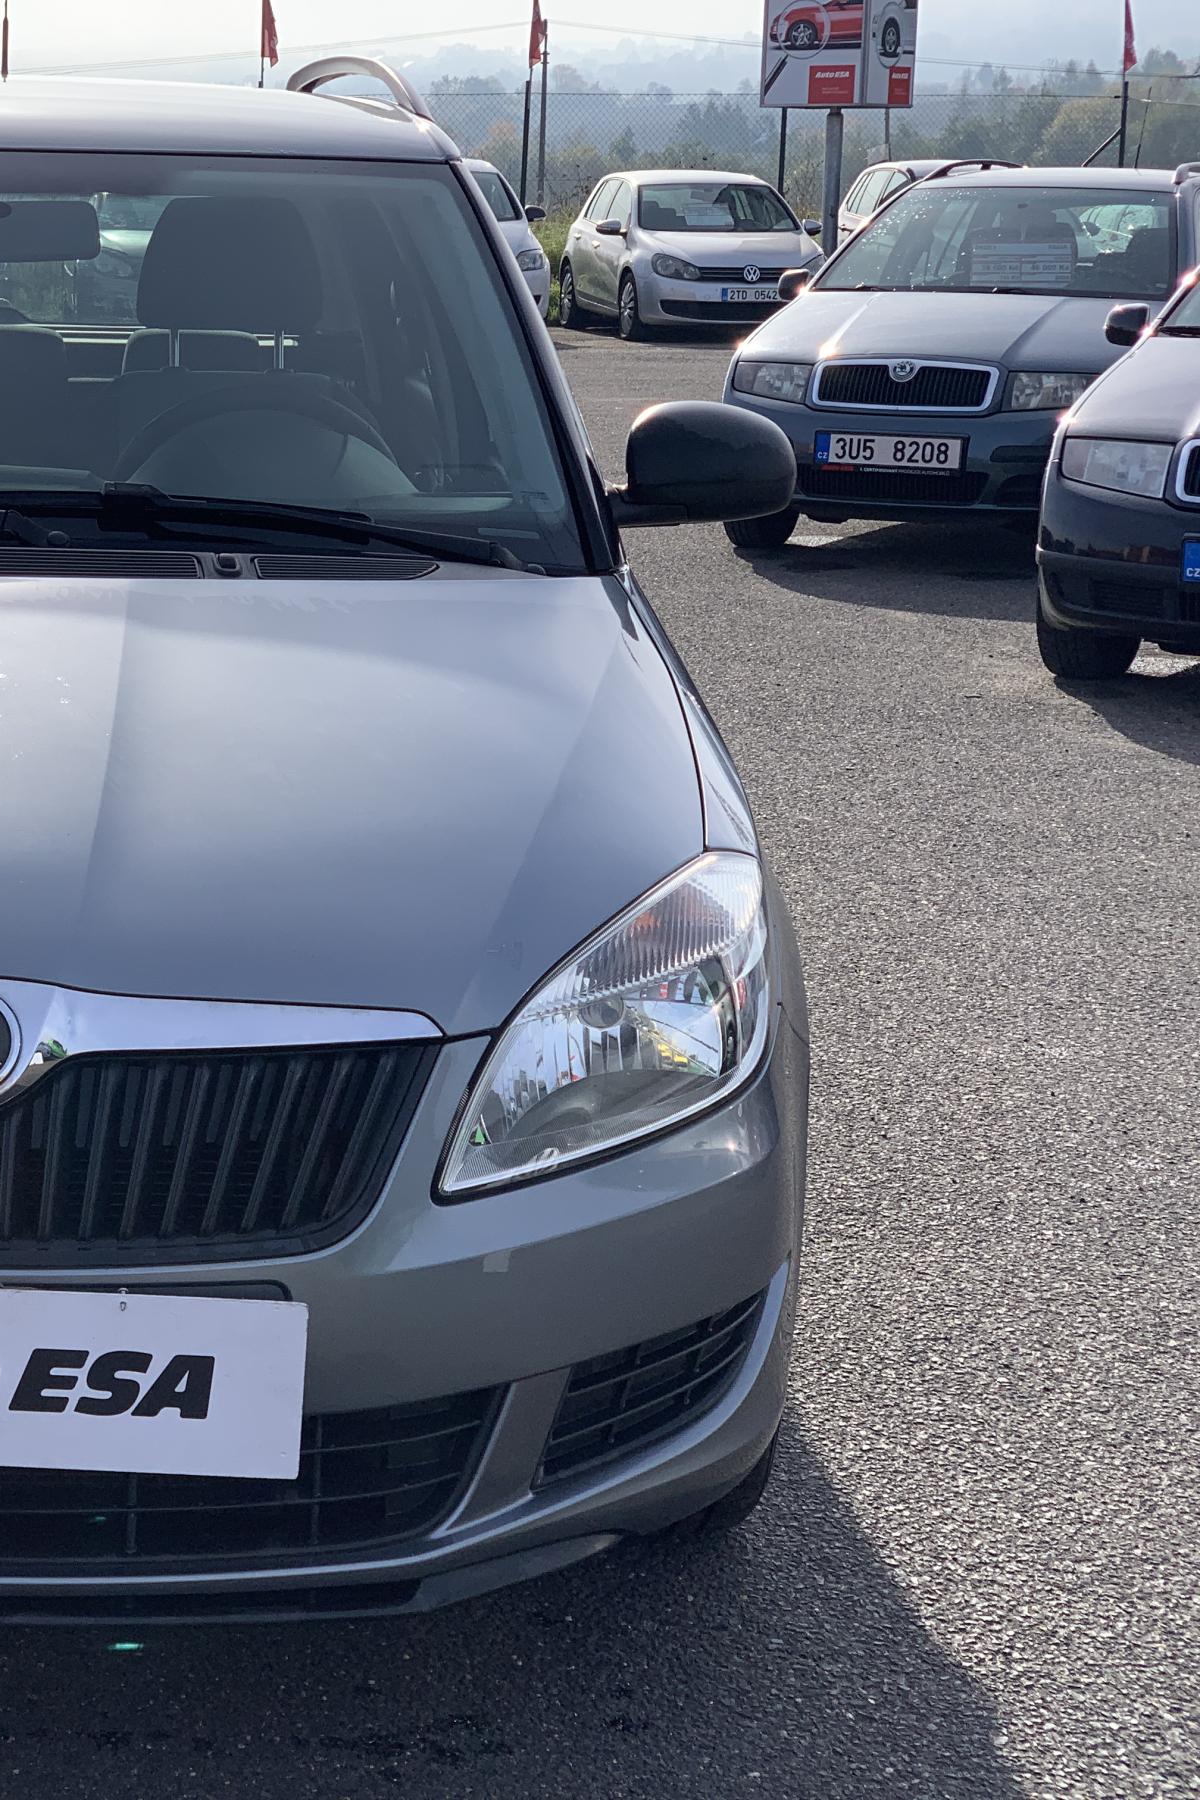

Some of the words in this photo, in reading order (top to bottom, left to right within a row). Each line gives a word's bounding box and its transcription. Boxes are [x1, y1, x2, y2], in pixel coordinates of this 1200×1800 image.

[730, 290, 748, 300] 2TD
[754, 290, 778, 300] 0542
[817, 451, 828, 459] CZ
[834, 437, 876, 461] 3U5
[892, 440, 950, 465] 8208
[1186, 567, 1200, 577] CZ
[8, 1347, 216, 1419] ESA
